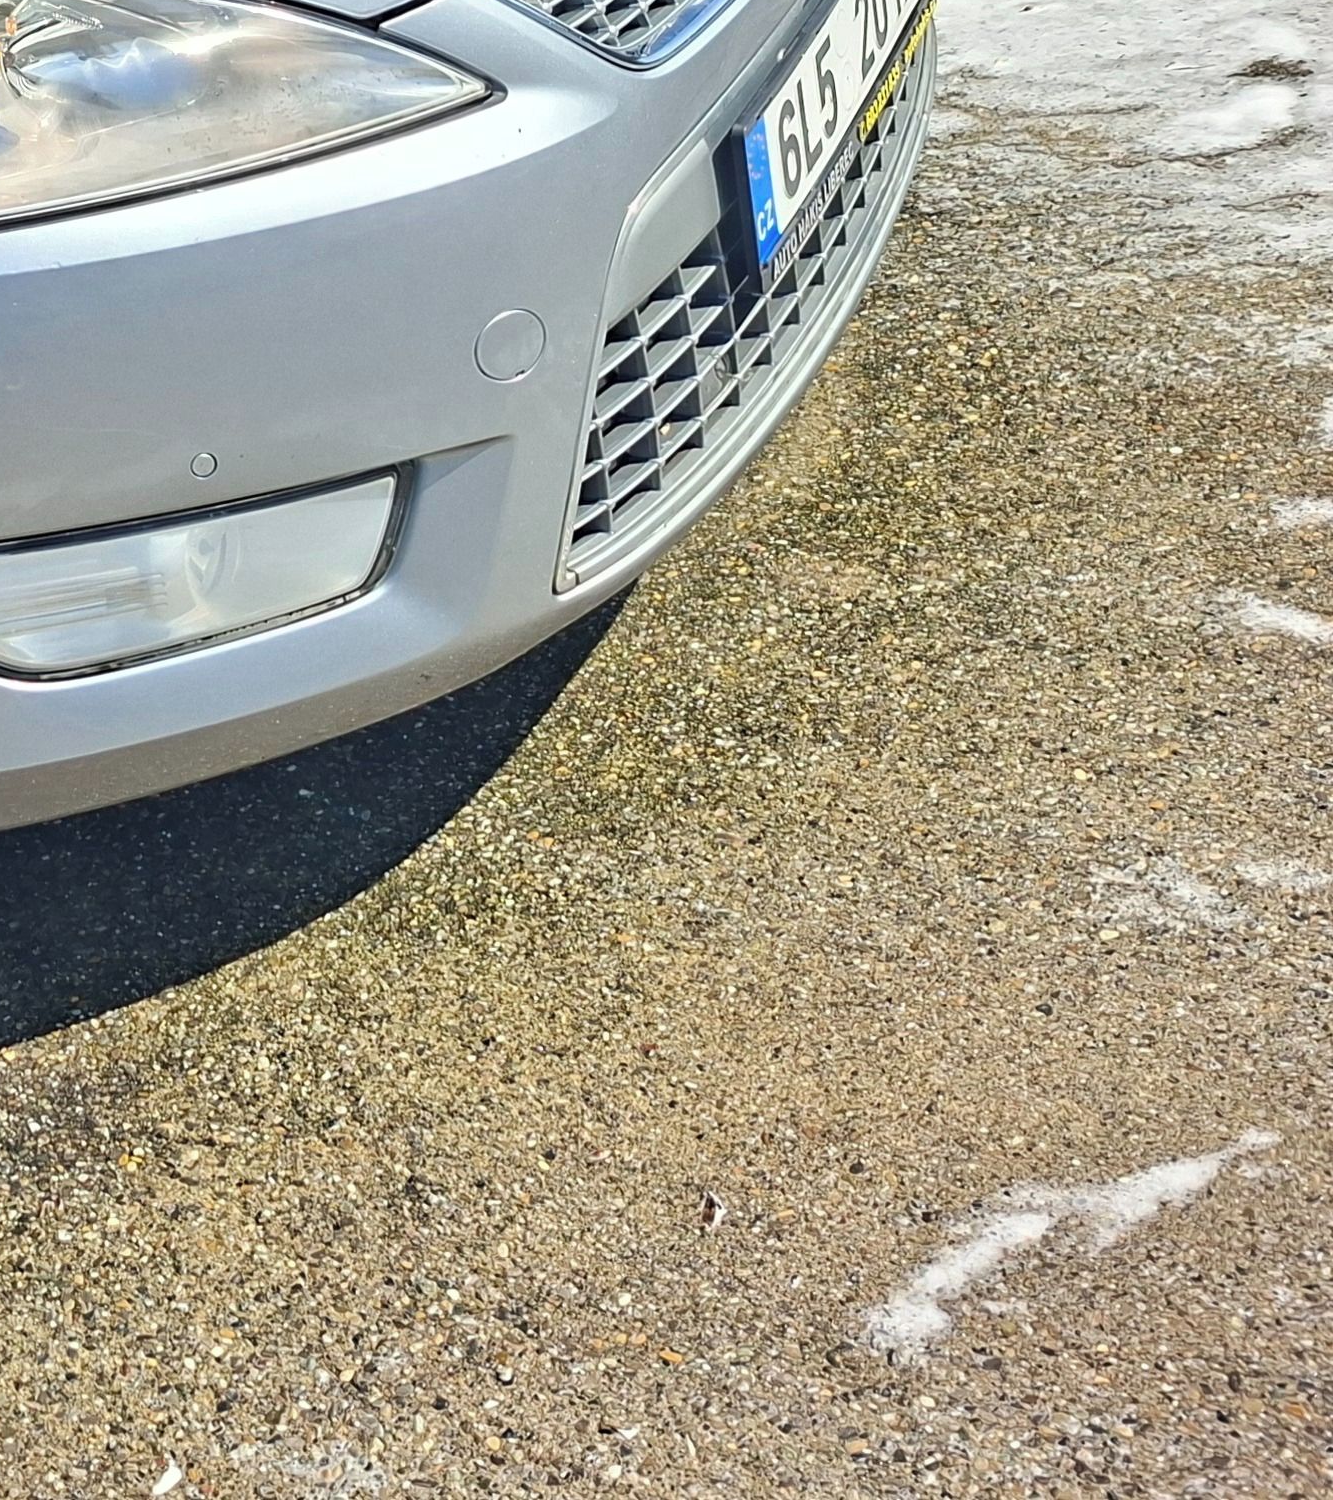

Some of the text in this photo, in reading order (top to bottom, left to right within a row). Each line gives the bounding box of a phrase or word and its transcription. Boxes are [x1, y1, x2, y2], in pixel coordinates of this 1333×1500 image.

[778, 32, 839, 200] 6L5
[756, 197, 775, 242] CZ
[772, 235, 799, 282] AUTO
[823, 141, 855, 206] LIBEREC
